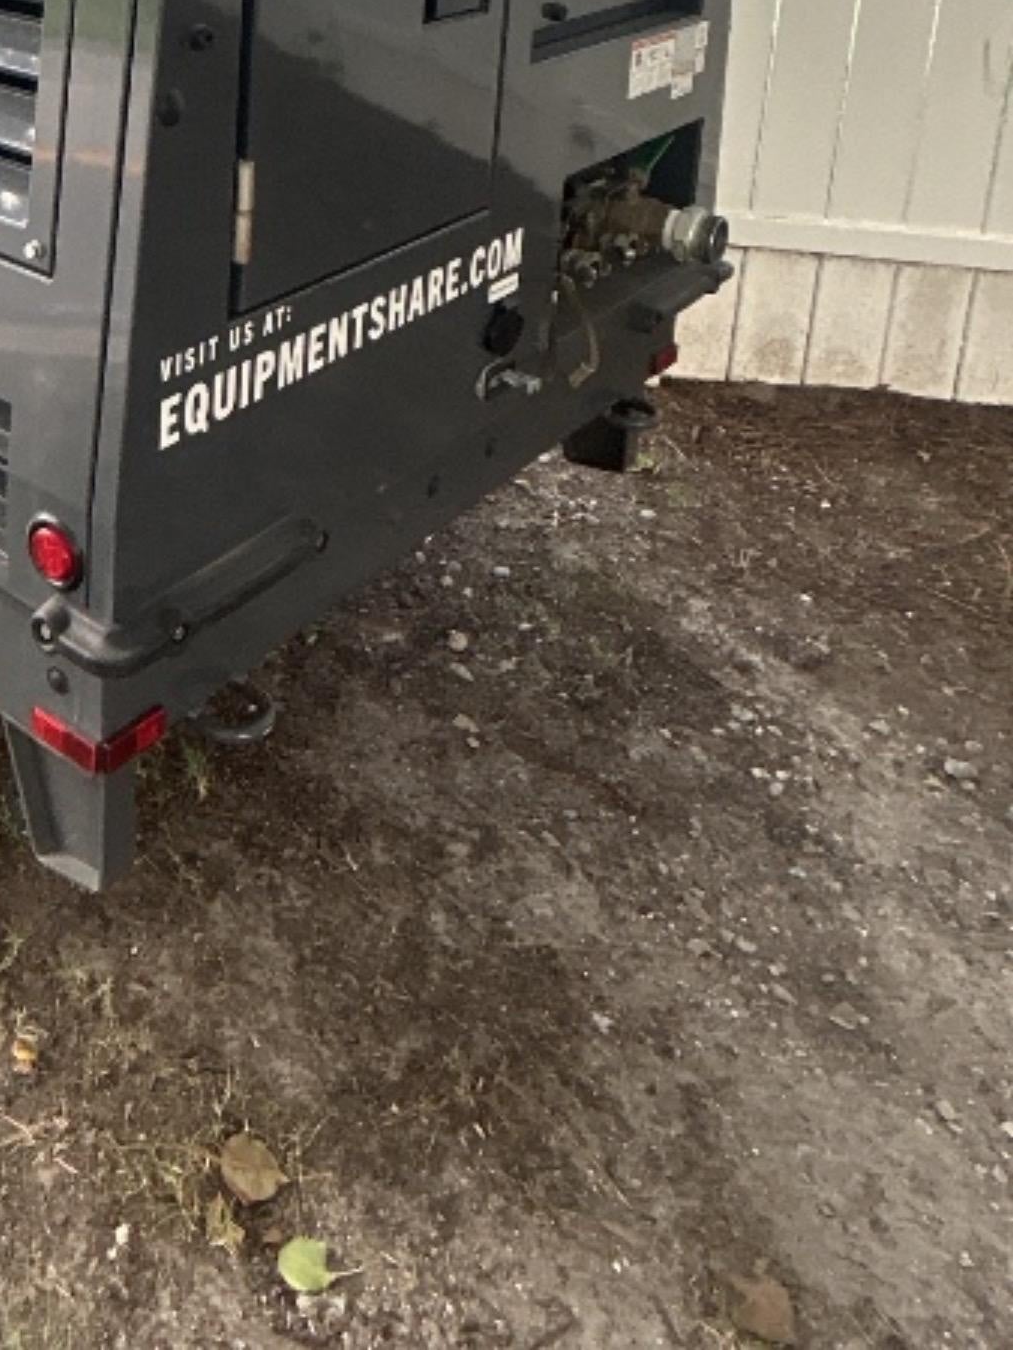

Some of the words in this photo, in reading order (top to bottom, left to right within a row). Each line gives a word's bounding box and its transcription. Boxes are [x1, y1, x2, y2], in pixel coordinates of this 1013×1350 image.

[158, 227, 524, 451] EQUIPMENTSHARE.COM
[160, 336, 218, 382] VISIT
[229, 321, 254, 352] US
[262, 305, 292, 337] AT:
